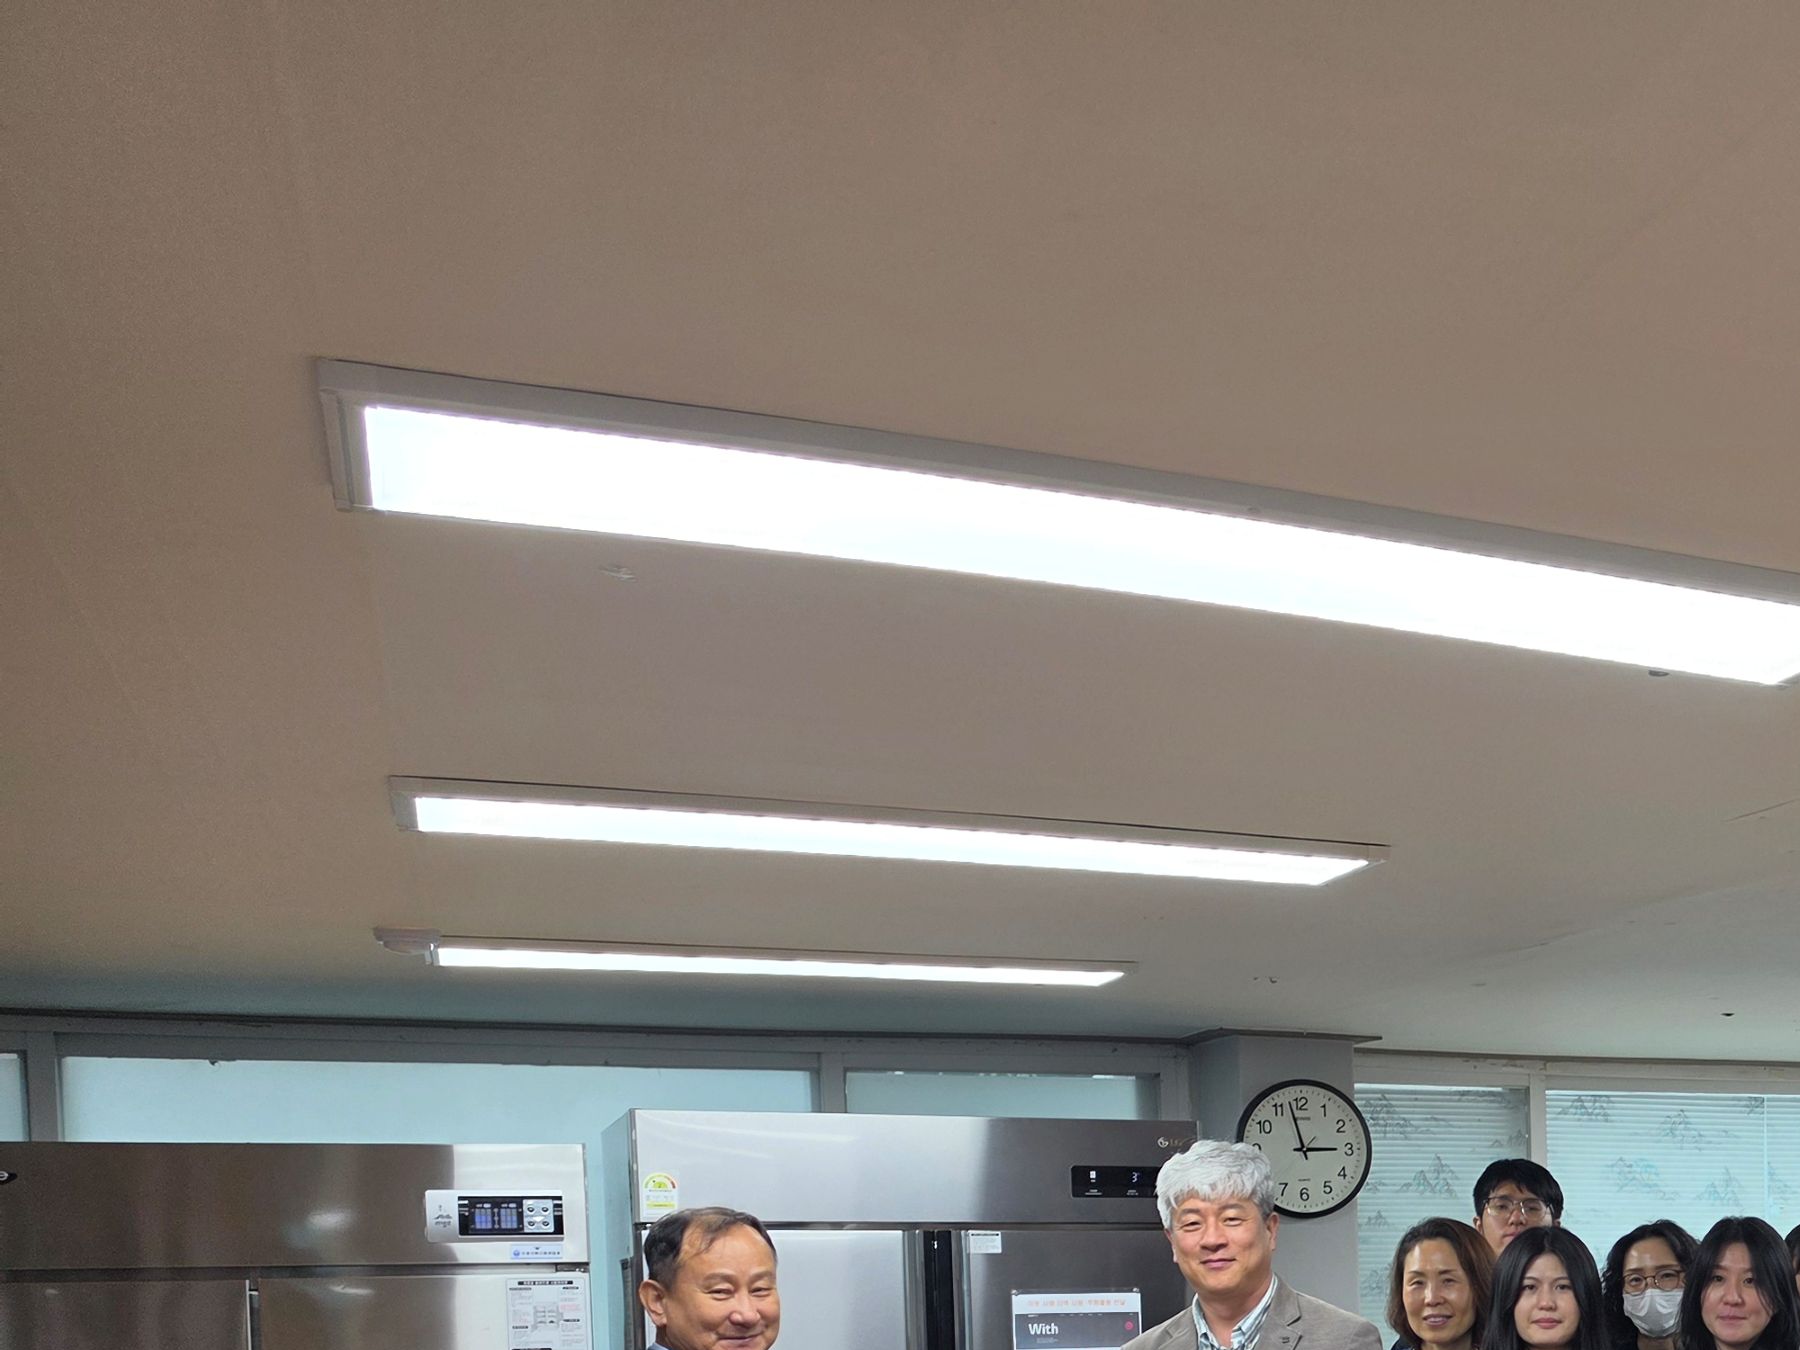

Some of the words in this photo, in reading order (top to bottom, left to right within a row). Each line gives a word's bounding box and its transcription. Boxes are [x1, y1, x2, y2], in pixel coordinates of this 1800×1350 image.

[1272, 1103, 1284, 1117] 11
[1293, 1097, 1308, 1111] 12
[1320, 1103, 1327, 1118] 1
[1256, 1119, 1272, 1135] 10
[1336, 1119, 1346, 1134] 2
[1344, 1142, 1354, 1157] 3
[1337, 1166, 1347, 1179] 4
[1279, 1183, 1289, 1197] 7
[1300, 1187, 1310, 1201] 6
[1323, 1180, 1333, 1194] 5
[1028, 1322, 1059, 1336] With
